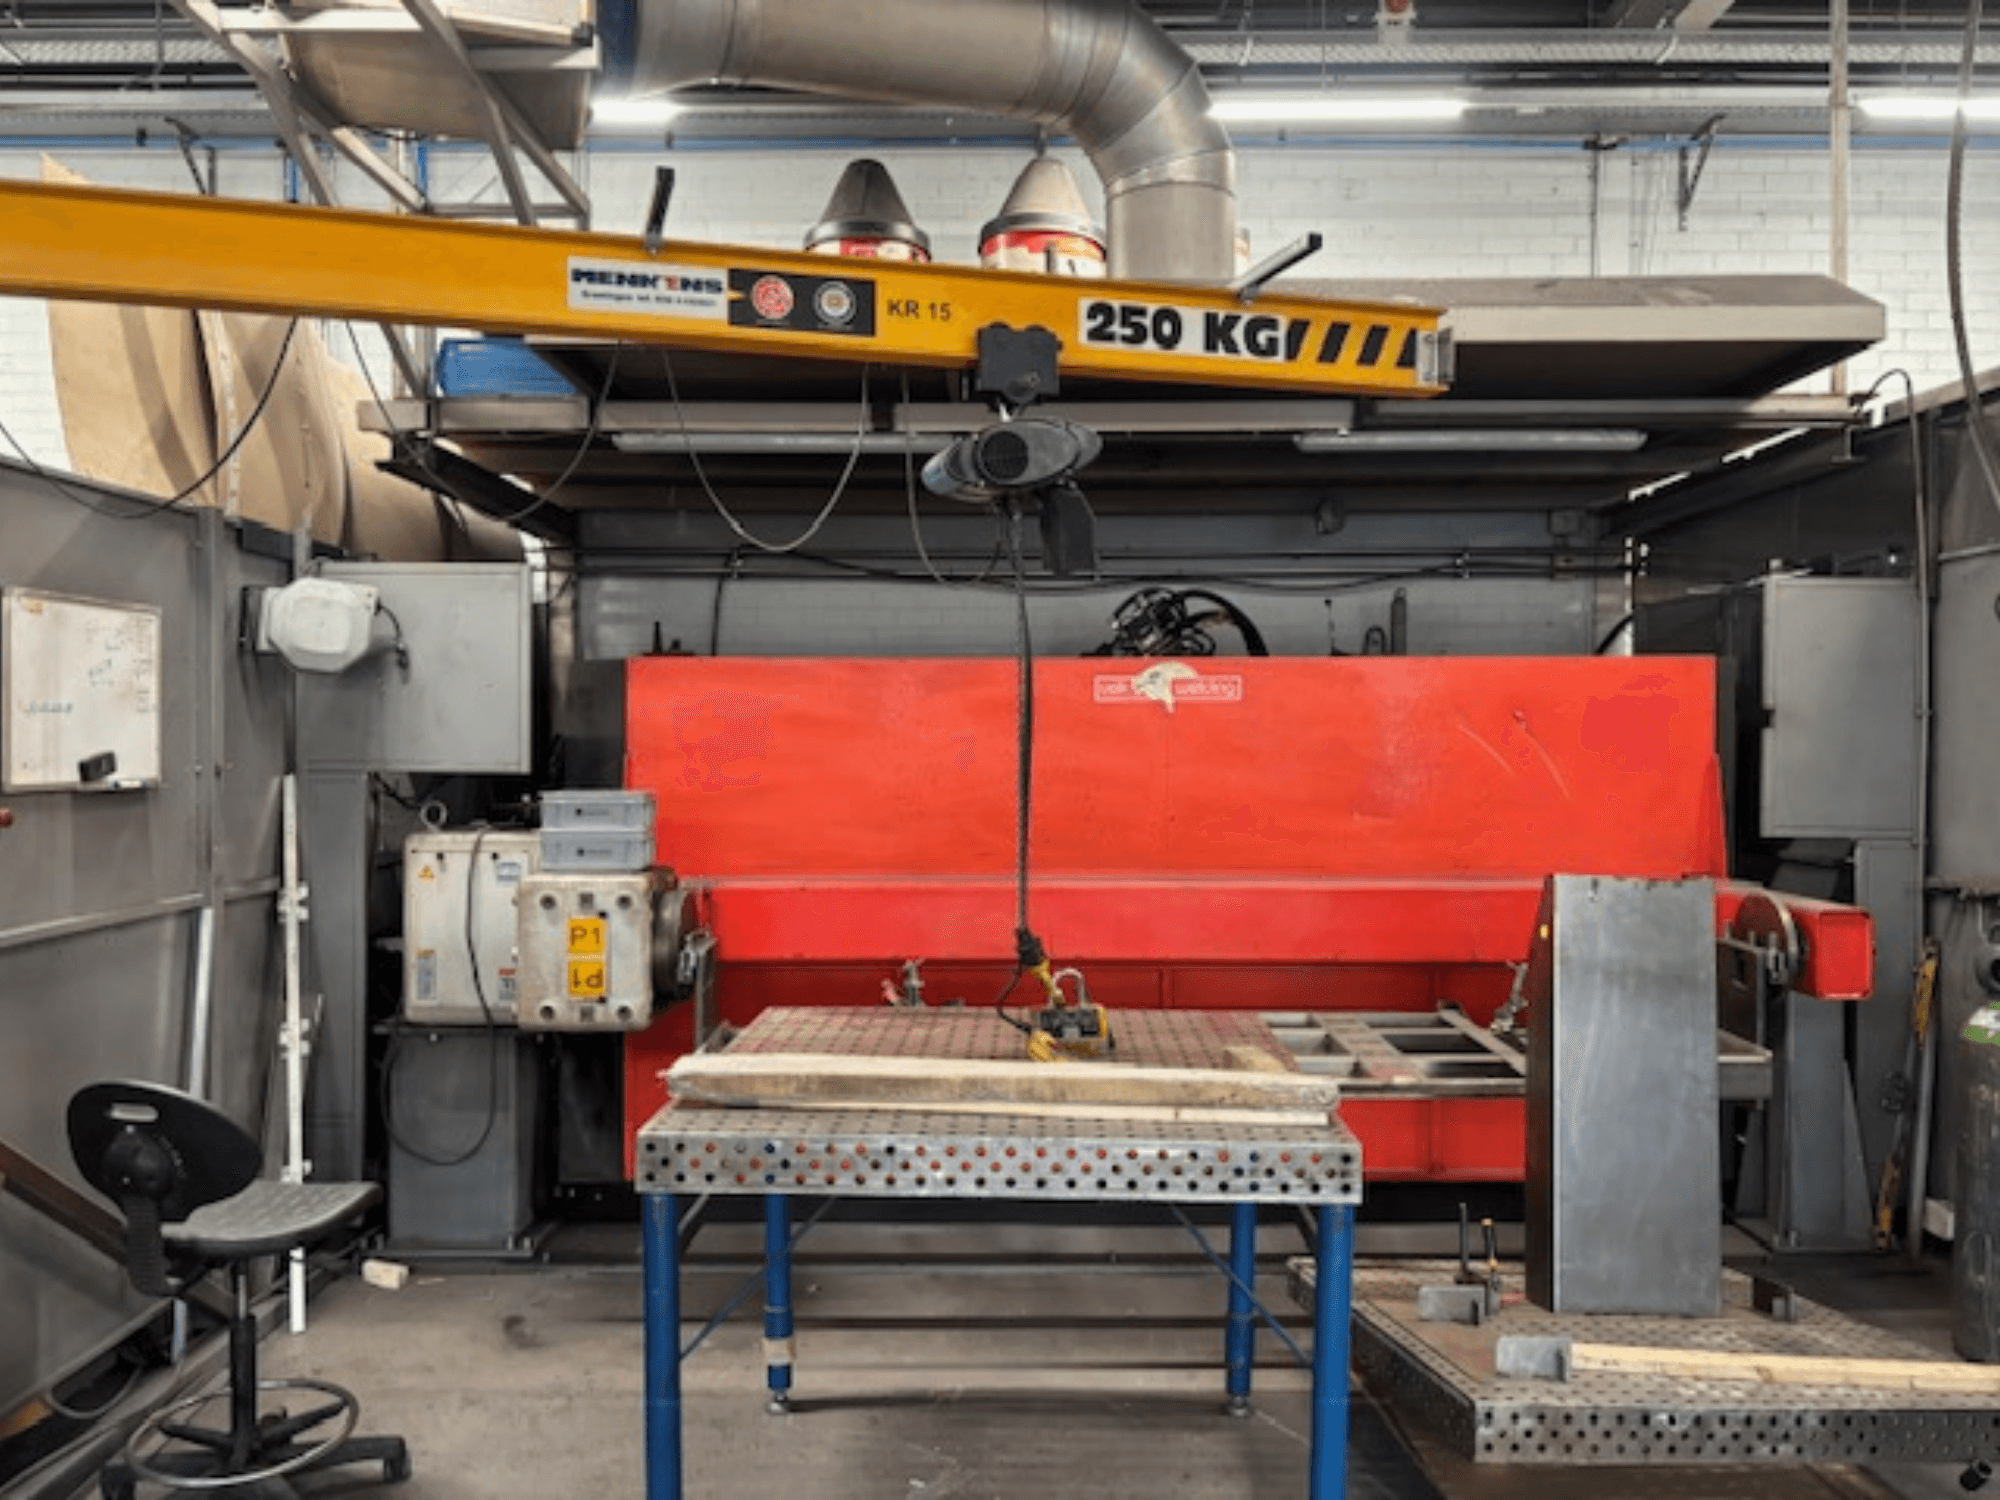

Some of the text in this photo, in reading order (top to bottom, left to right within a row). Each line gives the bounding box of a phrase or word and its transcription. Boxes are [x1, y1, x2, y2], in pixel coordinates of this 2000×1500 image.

[886, 298, 952, 322] KR 15
[1086, 302, 1279, 358] 250 KG
[570, 925, 601, 947] P1
